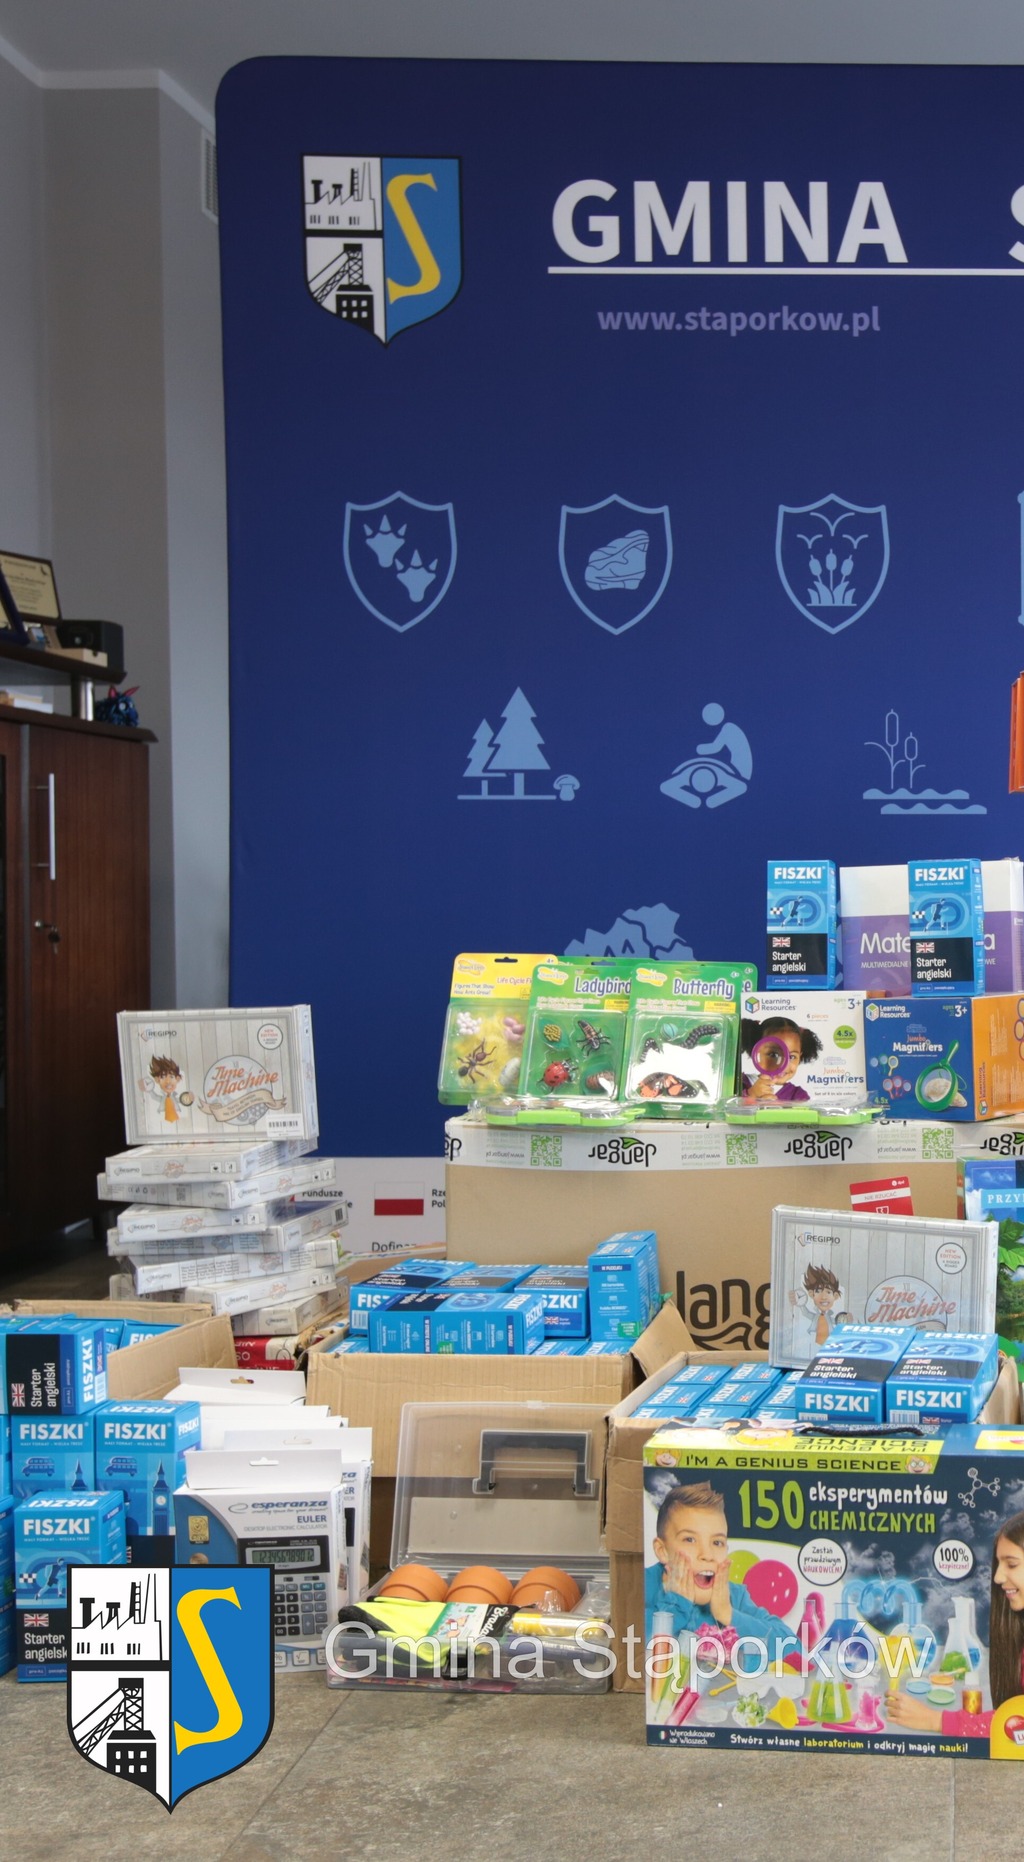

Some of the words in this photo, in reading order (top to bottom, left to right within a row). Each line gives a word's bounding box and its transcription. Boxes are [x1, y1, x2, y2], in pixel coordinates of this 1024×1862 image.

[552, 179, 909, 263] GMINA
[597, 306, 881, 337] www.staporkow.pl
[774, 867, 822, 879] FISZKI
[914, 866, 965, 881] FISZKI
[772, 951, 802, 961] Starter
[916, 957, 947, 968] Starter
[772, 962, 806, 974] angielski
[861, 961, 909, 969] MULTIMEDIALNE
[917, 968, 952, 981] angielski
[509, 977, 523, 986] Cycle
[575, 976, 631, 997] Ladybird
[674, 979, 734, 999] Butterfly
[761, 998, 791, 1006] Learning
[847, 998, 861, 1010] 3+
[880, 1005, 905, 1013] Learning
[954, 1005, 967, 1018] 3+
[907, 1034, 926, 1043] Jumbo
[893, 1039, 943, 1053] Magnifiers
[211, 1065, 245, 1080] Time
[807, 1072, 864, 1085] Magnifiers
[207, 1069, 279, 1098] Machine
[588, 1138, 656, 1167] Jangar
[784, 1131, 853, 1161] Jangar
[302, 1188, 343, 1197] Fundusze
[876, 1191, 897, 1200] RZUCAĆ
[807, 1235, 841, 1244] REGIPIO
[875, 1286, 916, 1303] Time
[868, 1296, 956, 1323] Machine
[841, 1325, 905, 1334] FISZKI
[924, 1332, 987, 1340] FISZKI
[82, 1338, 94, 1402] FISZKI
[809, 1371, 857, 1379] angielski
[30, 1368, 43, 1407] Starter
[43, 1362, 59, 1407] angielski
[805, 1393, 870, 1412] FISZKI
[896, 1390, 962, 1409] FISZKI
[20, 1424, 83, 1440] FISZKI
[104, 1423, 166, 1439] FISZKI
[178, 1416, 199, 1435] FISZKI
[686, 1454, 708, 1466] I'M
[716, 1457, 729, 1466] A
[735, 1457, 809, 1469] GENIUS
[817, 1459, 901, 1471] SCIENCE
[809, 1481, 948, 1509] eksperymentów
[28, 1499, 98, 1508] FISZKI
[251, 1500, 328, 1510] esperanza
[738, 1479, 805, 1529] 150
[297, 1515, 327, 1524] EULER
[809, 1511, 936, 1533] CHEMICZNYCH
[23, 1519, 90, 1535] FISZKI
[811, 1546, 833, 1555] Zostań
[940, 1547, 969, 1562] 100%
[804, 1555, 841, 1565] prawdziwym
[803, 1564, 843, 1574] NAUKOWCEM!
[939, 1562, 969, 1572] bezpieczne!
[24, 1633, 65, 1645] Starter
[669, 1729, 716, 1738] Wyprodukowano
[679, 1737, 708, 1745] Włoszech
[730, 1734, 763, 1744] Stwórz
[803, 1737, 864, 1749] laboratorium
[867, 1741, 871, 1749] i
[874, 1740, 905, 1753] odkryj
[909, 1742, 936, 1753] magię
[939, 1743, 968, 1753] nauki!
